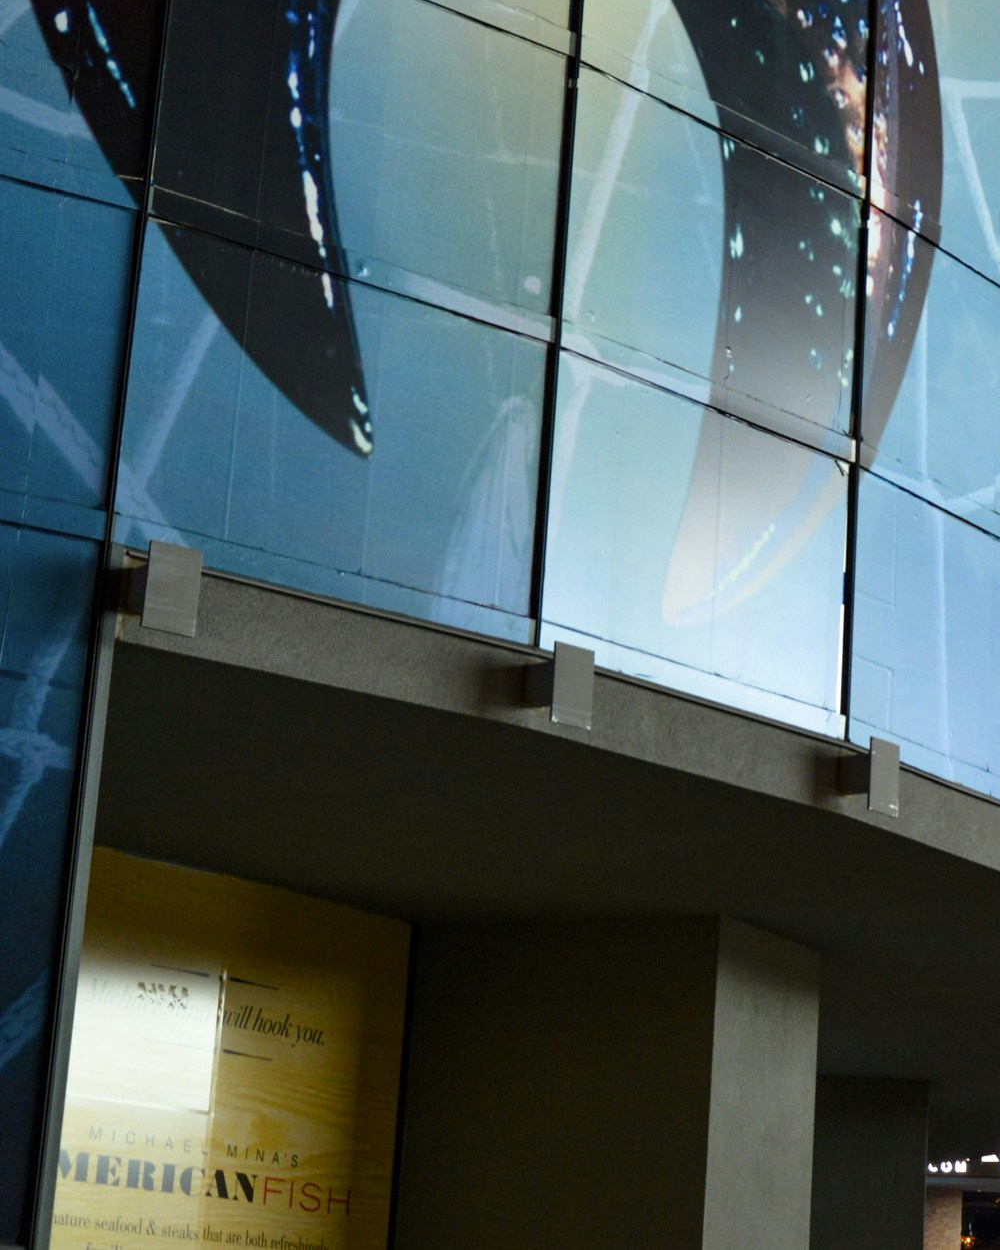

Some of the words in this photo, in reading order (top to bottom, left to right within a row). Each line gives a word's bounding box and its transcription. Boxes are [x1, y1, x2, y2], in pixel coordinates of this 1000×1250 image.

[222, 1005, 253, 1030] will
[255, 1008, 292, 1039] hook
[291, 1024, 326, 1048] you.
[89, 1126, 209, 1156] MICHAEL
[226, 1144, 299, 1168] MINA'S
[57, 1149, 258, 1203] MERICAN
[52, 1213, 91, 1228] nature
[94, 1215, 142, 1235] seafood
[146, 1218, 158, 1237] &
[160, 1223, 199, 1241] steaks
[202, 1225, 223, 1242] that
[225, 1232, 243, 1245] are
[245, 1230, 268, 1248] both
